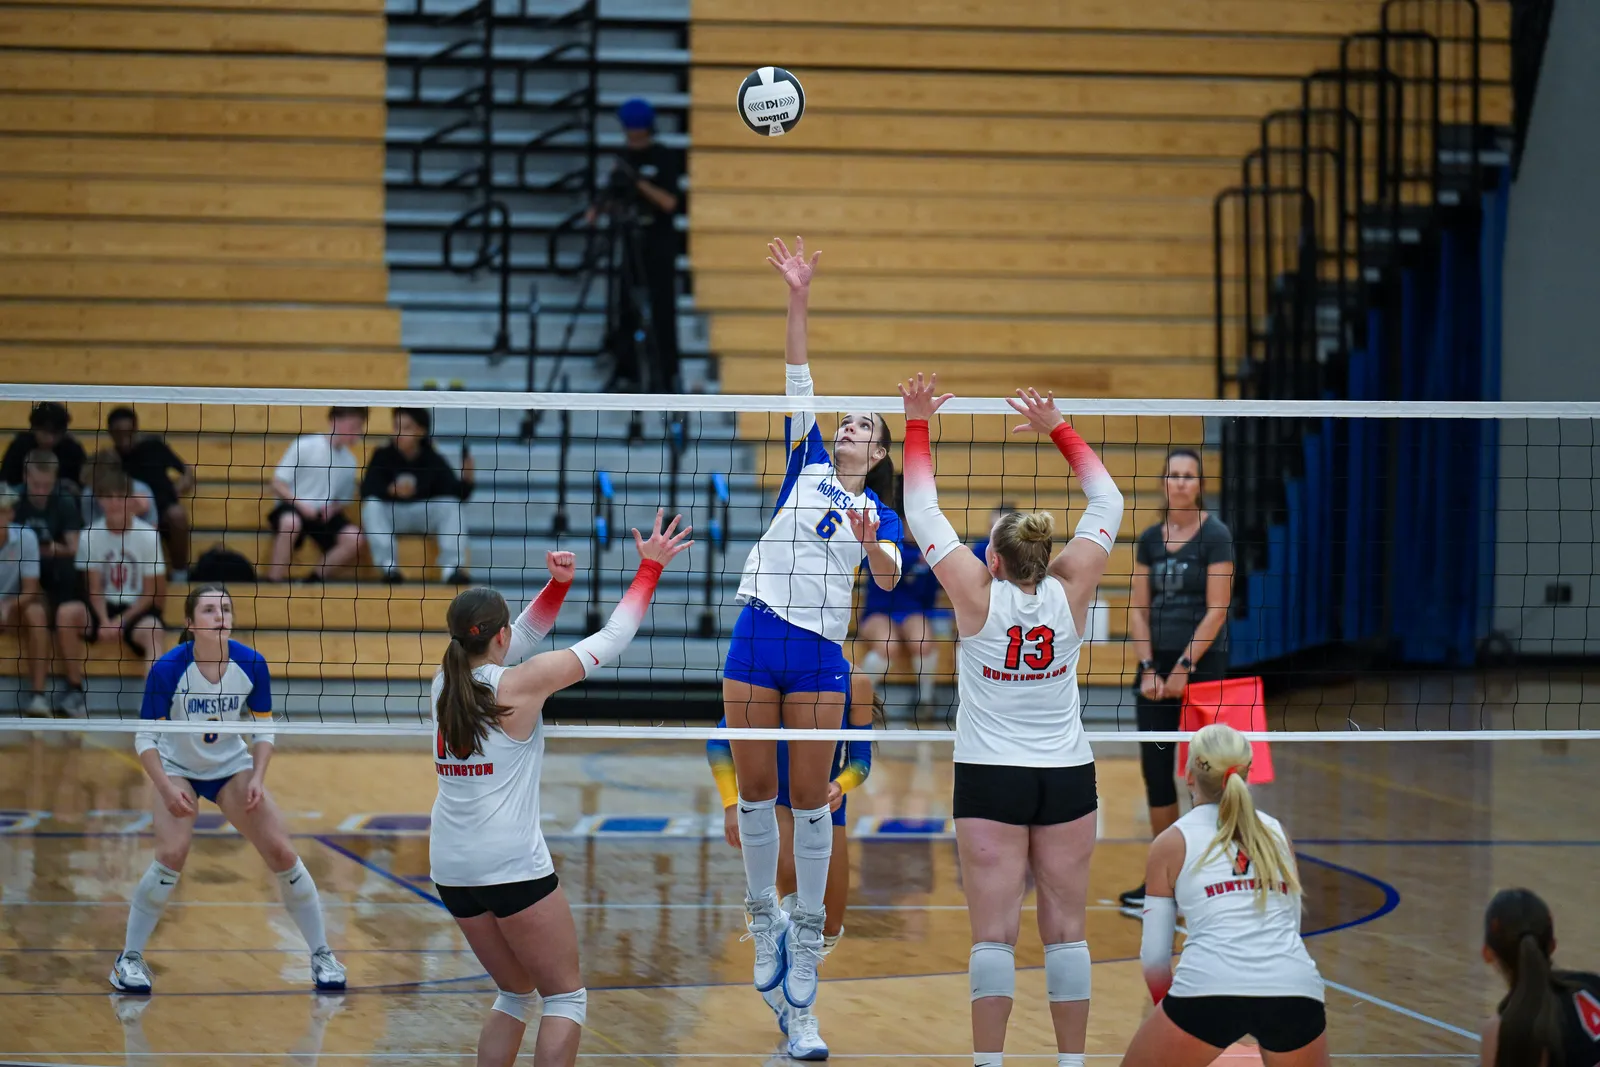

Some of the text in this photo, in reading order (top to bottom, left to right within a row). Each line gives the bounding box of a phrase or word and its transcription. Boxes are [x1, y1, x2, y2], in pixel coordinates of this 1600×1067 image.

[757, 111, 789, 122] Wilson
[815, 509, 843, 540] 6
[1004, 624, 1055, 670] 13
[187, 695, 240, 715] HOMESTEAD
